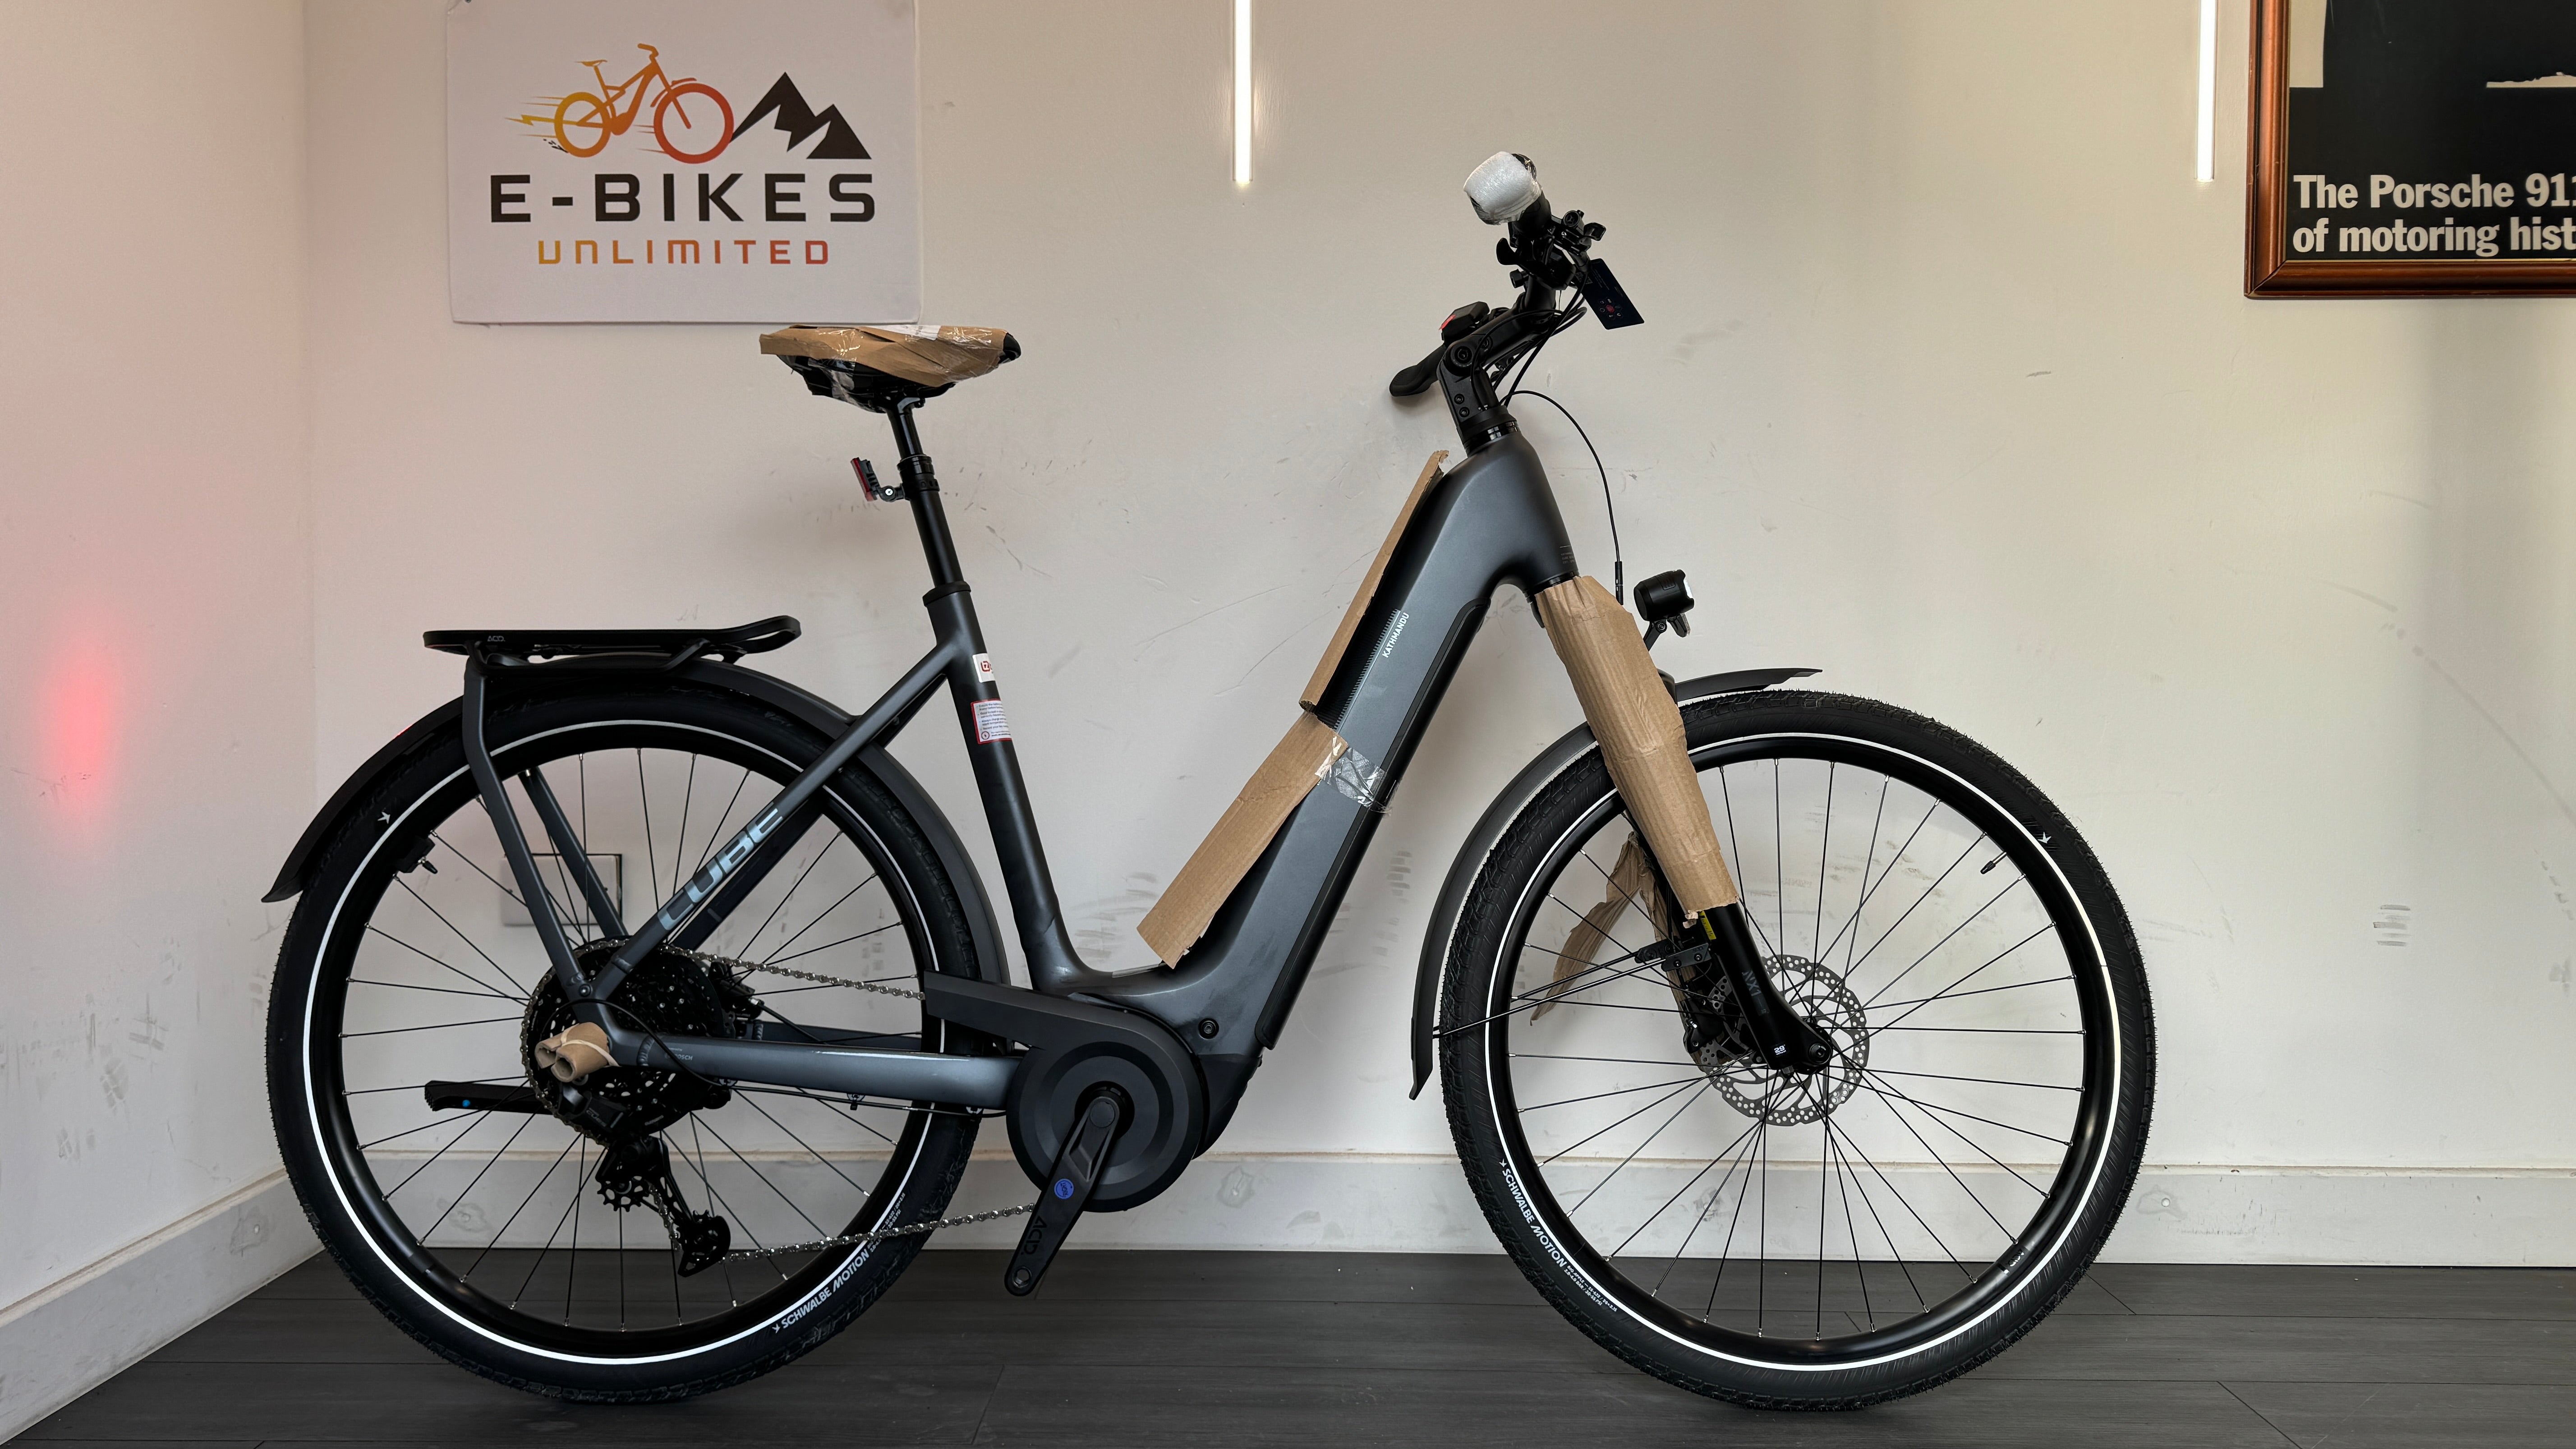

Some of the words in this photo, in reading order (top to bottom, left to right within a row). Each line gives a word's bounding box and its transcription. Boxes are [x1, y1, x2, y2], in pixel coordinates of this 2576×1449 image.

[490, 173, 875, 223] E-BIKES
[2293, 175, 2358, 208] The
[2370, 174, 2515, 208] Porsche
[538, 240, 829, 265] UNLIMITED
[2293, 218, 2328, 253] of
[2340, 217, 2499, 257] motoring
[1382, 612, 1410, 658] KATHMANDU
[657, 801, 783, 931] CUBE
[1502, 1168, 1535, 1224] SCHWALBE
[1531, 1224, 1567, 1268] MOTION
[782, 1287, 833, 1329] SCHWALBE
[832, 1248, 869, 1293] MOTION
